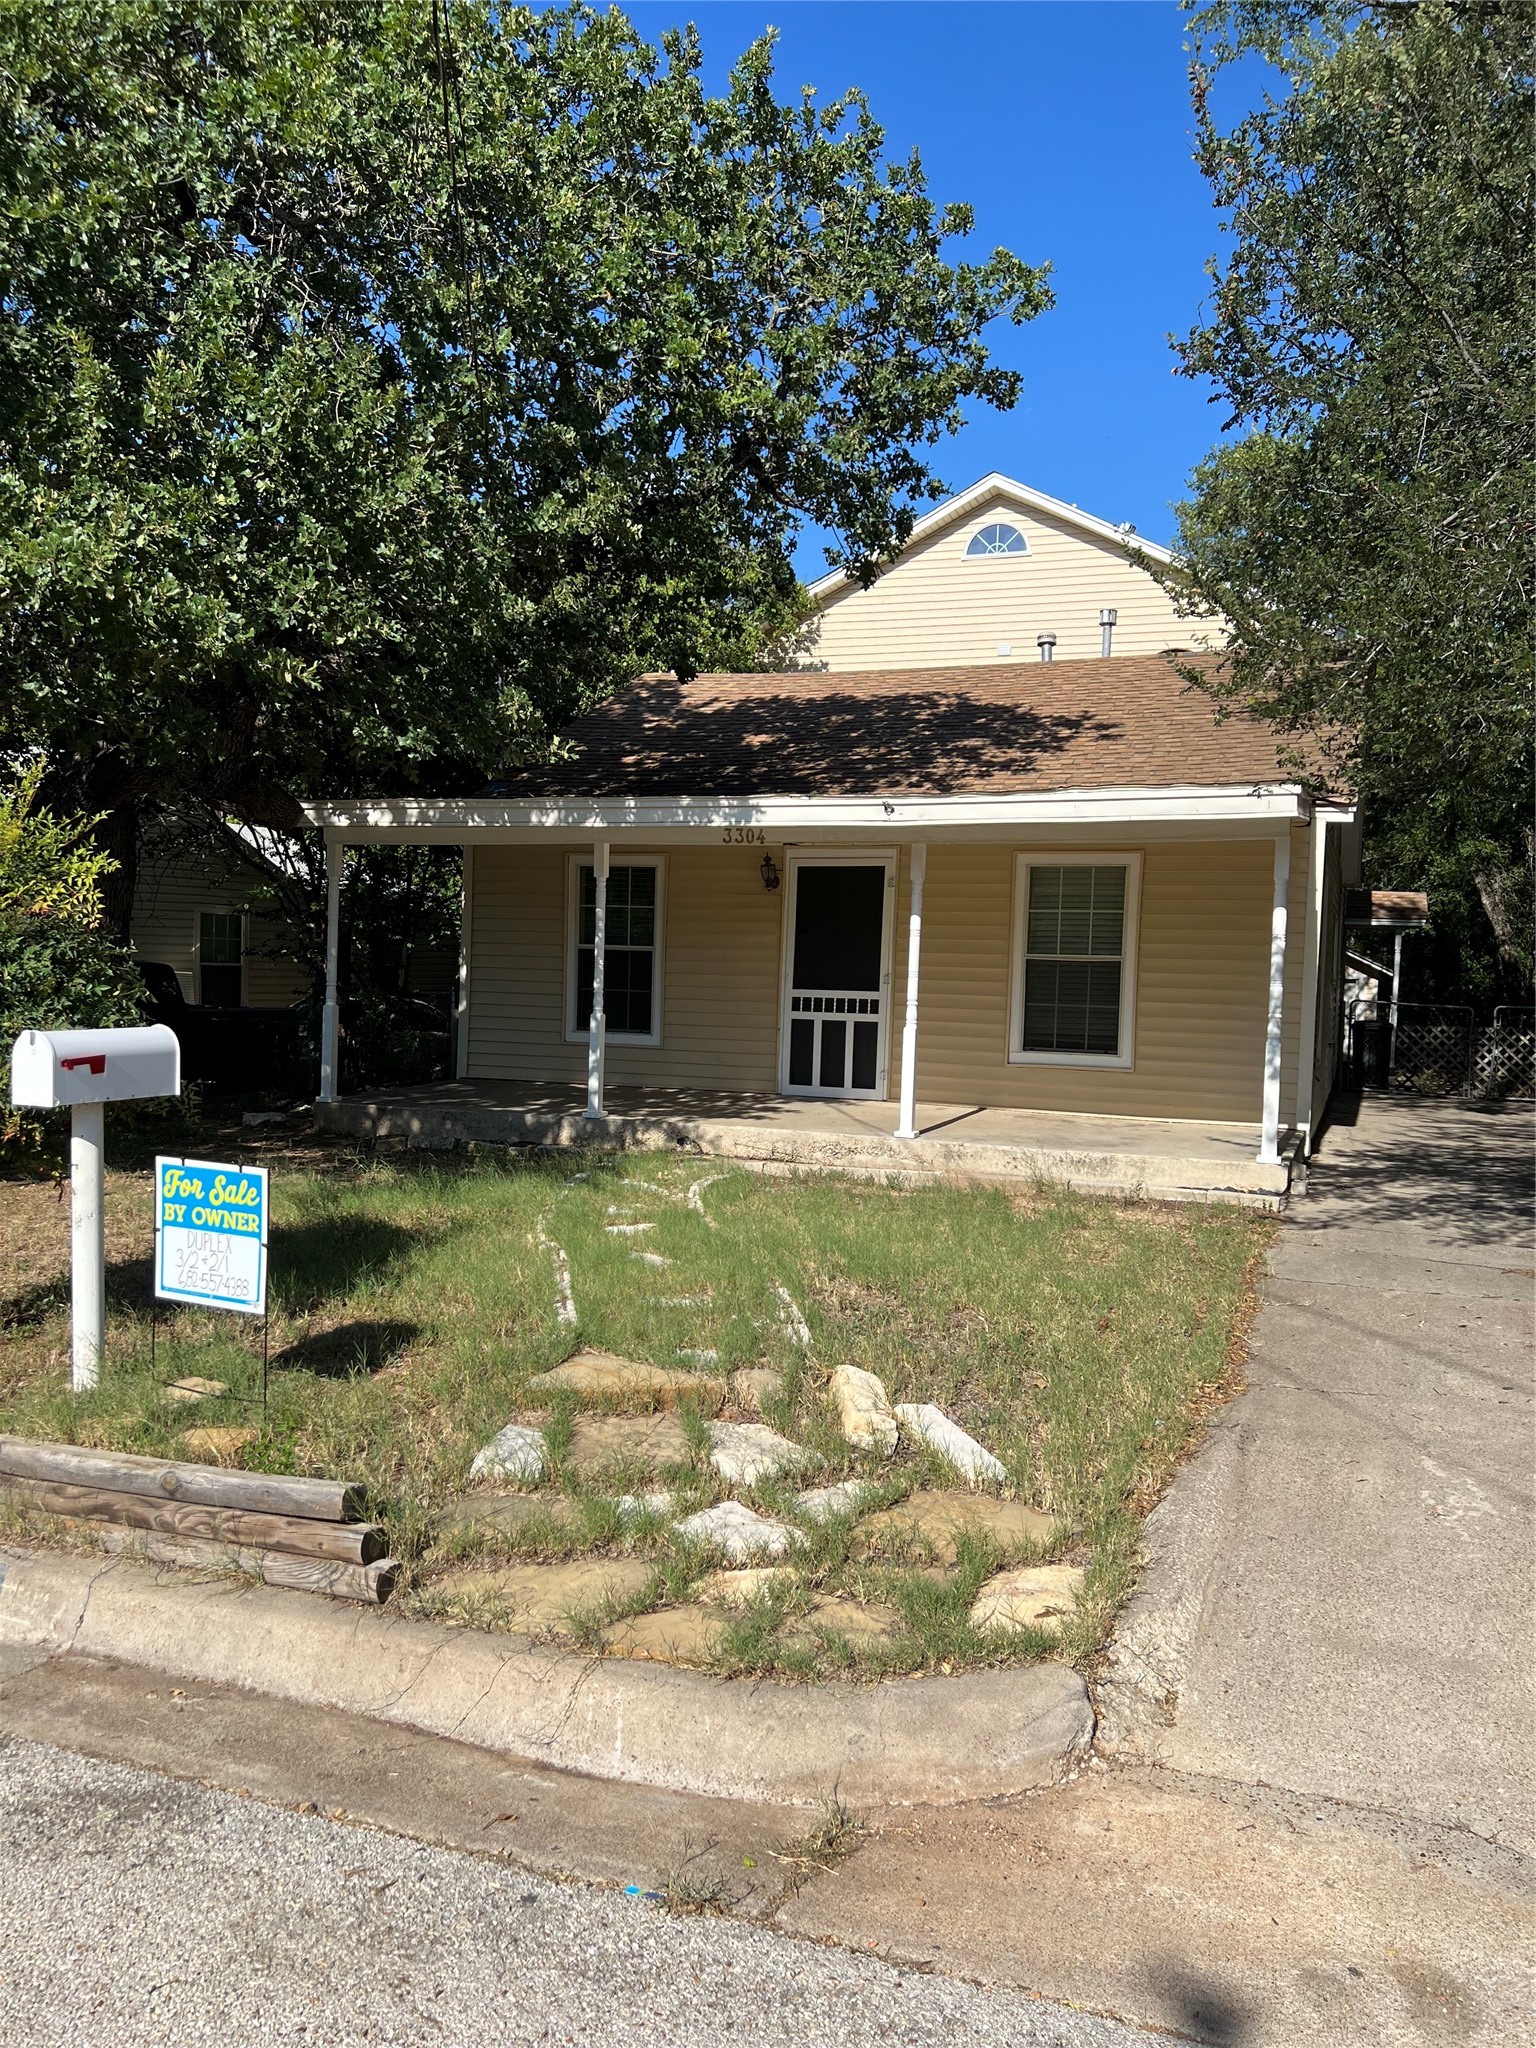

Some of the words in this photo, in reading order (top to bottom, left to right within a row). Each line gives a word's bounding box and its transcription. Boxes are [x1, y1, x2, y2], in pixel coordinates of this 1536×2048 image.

[723, 828, 766, 844] 3304
[163, 1169, 205, 1199] For
[209, 1174, 260, 1206] Sale
[164, 1202, 187, 1222] BY
[191, 1206, 260, 1232] OWNER
[187, 1230, 233, 1254] DUPLEX
